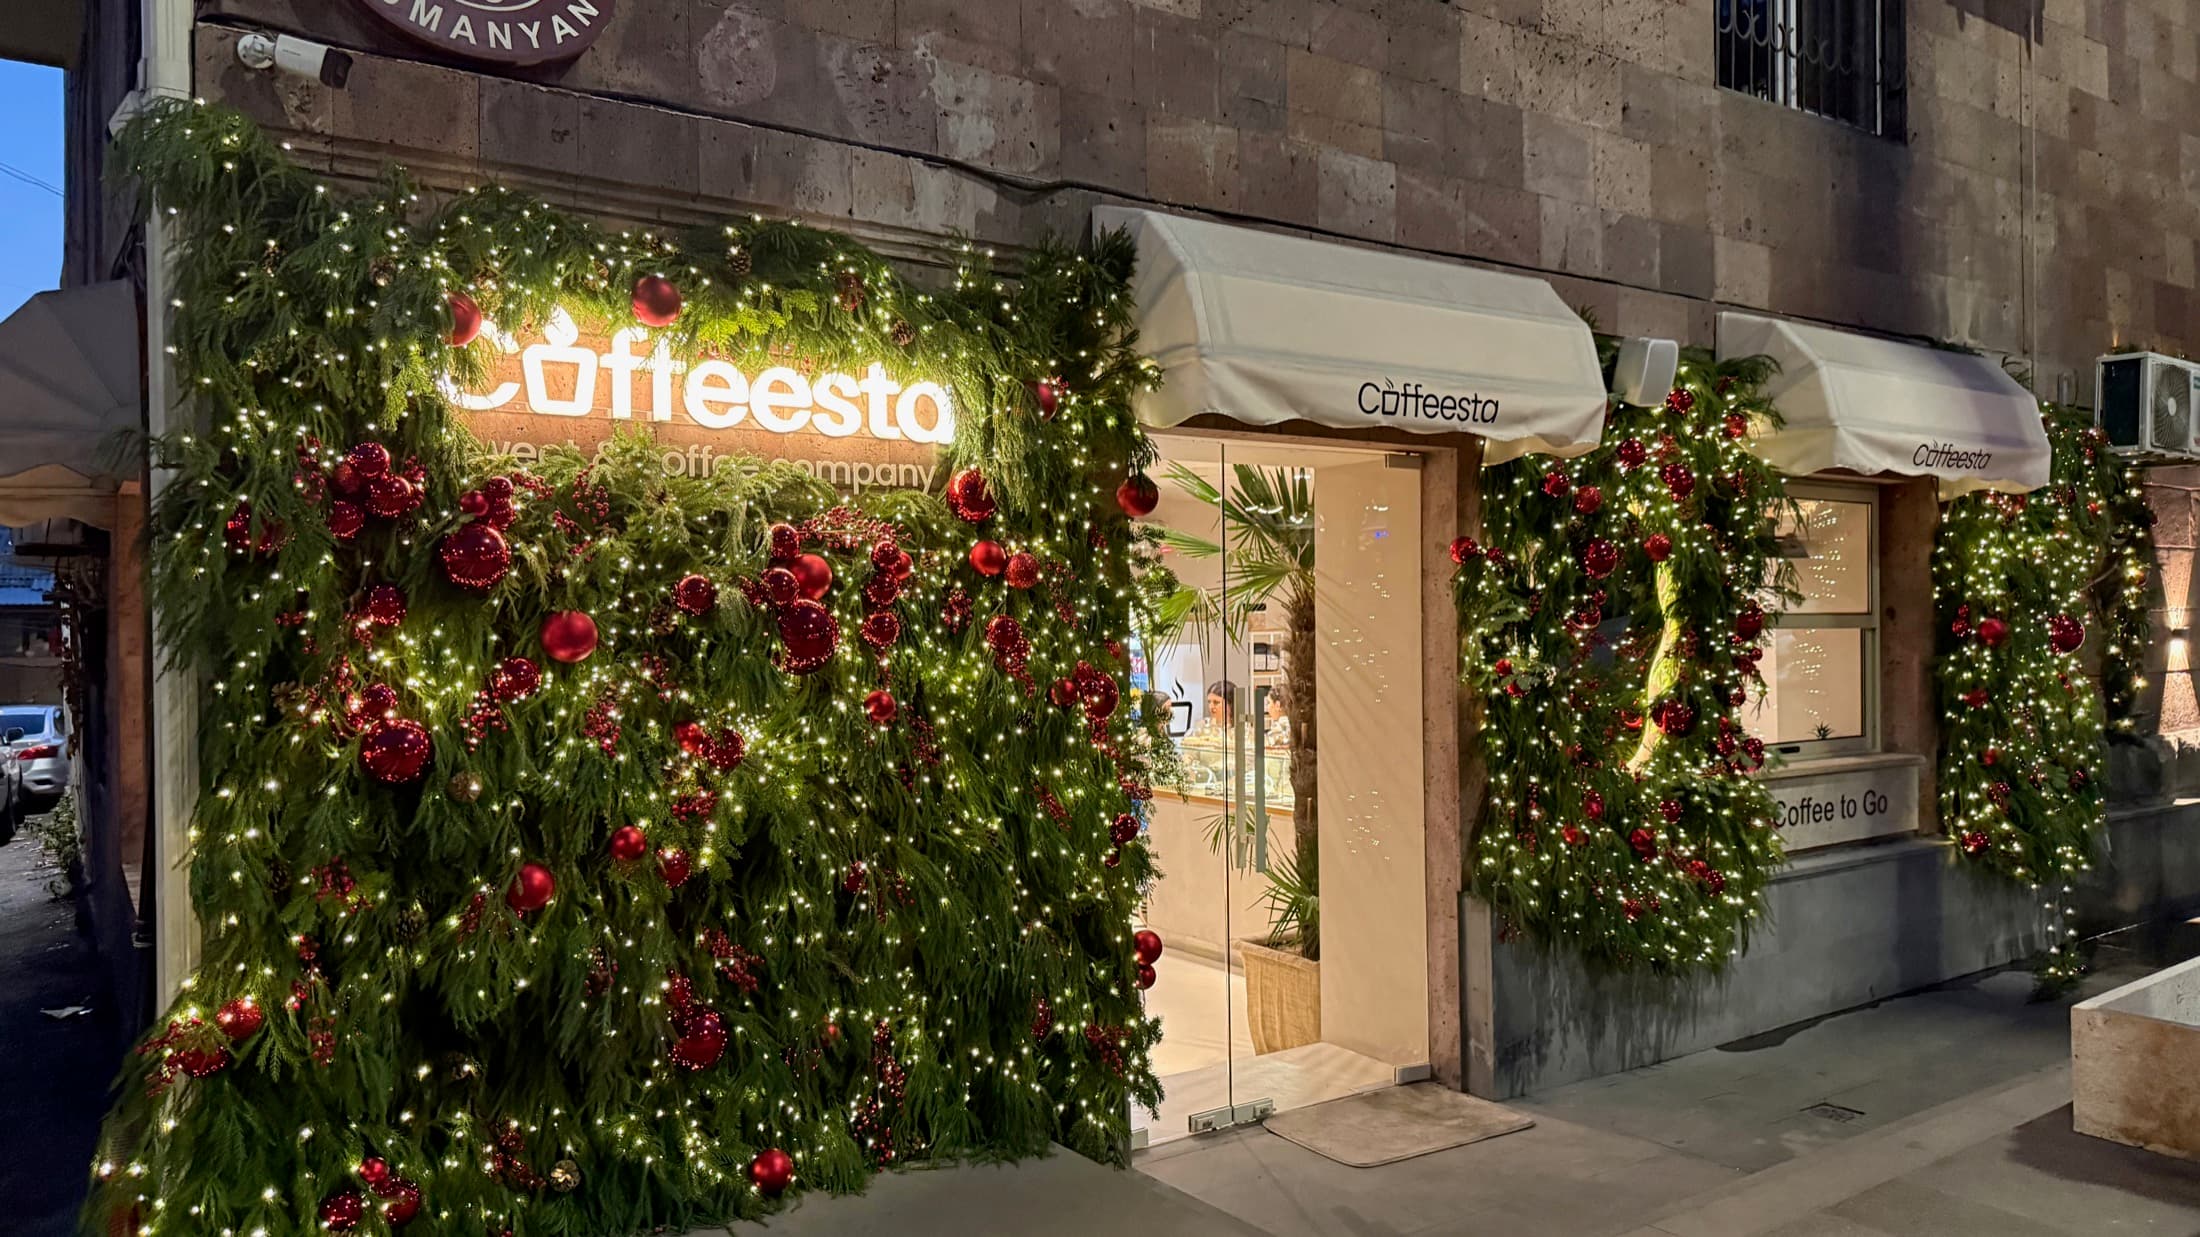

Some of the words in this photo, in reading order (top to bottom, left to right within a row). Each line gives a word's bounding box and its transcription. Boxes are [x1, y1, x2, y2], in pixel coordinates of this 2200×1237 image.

[384, 0, 600, 50] MANYAN
[1358, 376, 1499, 423] Coffeesta
[1913, 440, 1992, 469] Coffeesta
[1774, 797, 1834, 827] Coffee
[1840, 794, 1857, 819] to
[1863, 789, 1888, 816] Go
